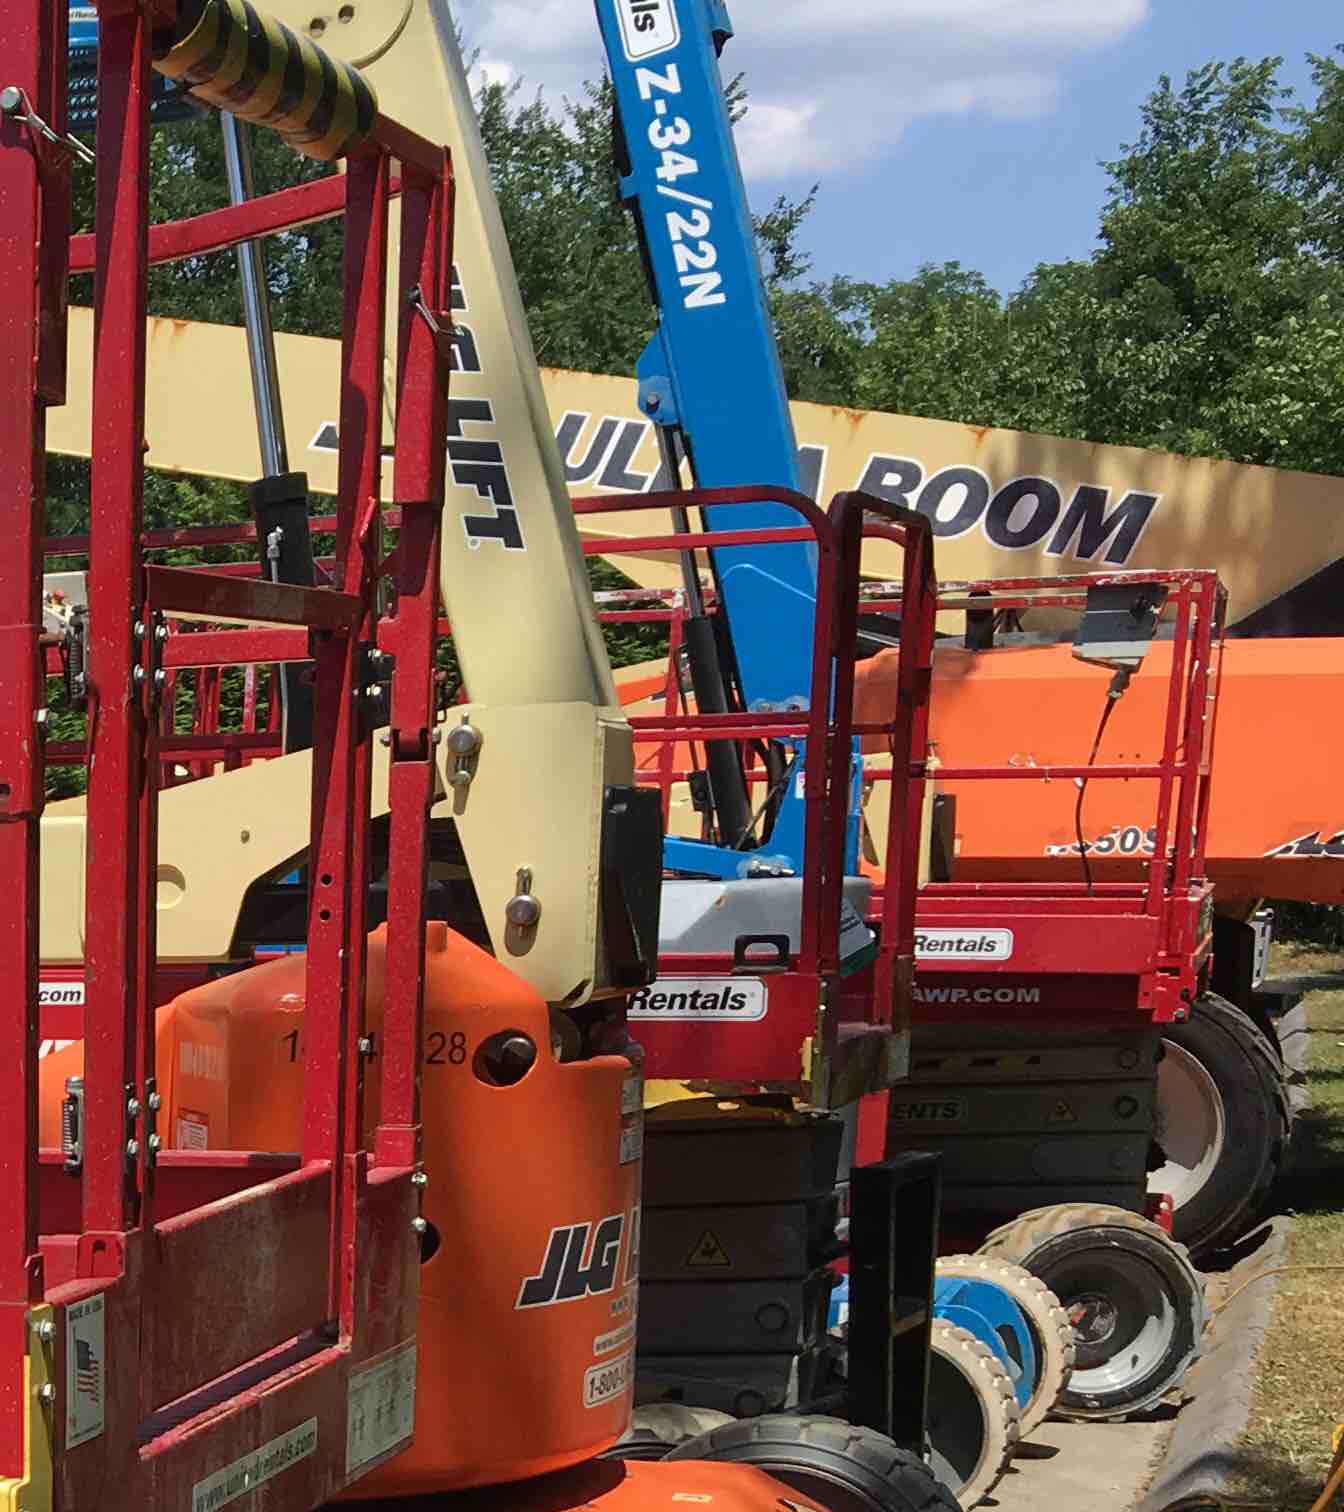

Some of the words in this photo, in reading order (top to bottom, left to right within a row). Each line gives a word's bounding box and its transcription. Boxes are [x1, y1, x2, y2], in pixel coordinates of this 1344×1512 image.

[635, 63, 727, 311] Z-34/22N
[447, 396, 527, 553] LIFT
[852, 453, 1164, 567] BOOM
[627, 979, 748, 1012] Rentals
[914, 934, 997, 954] Rentals
[515, 1215, 624, 1310] JLG
